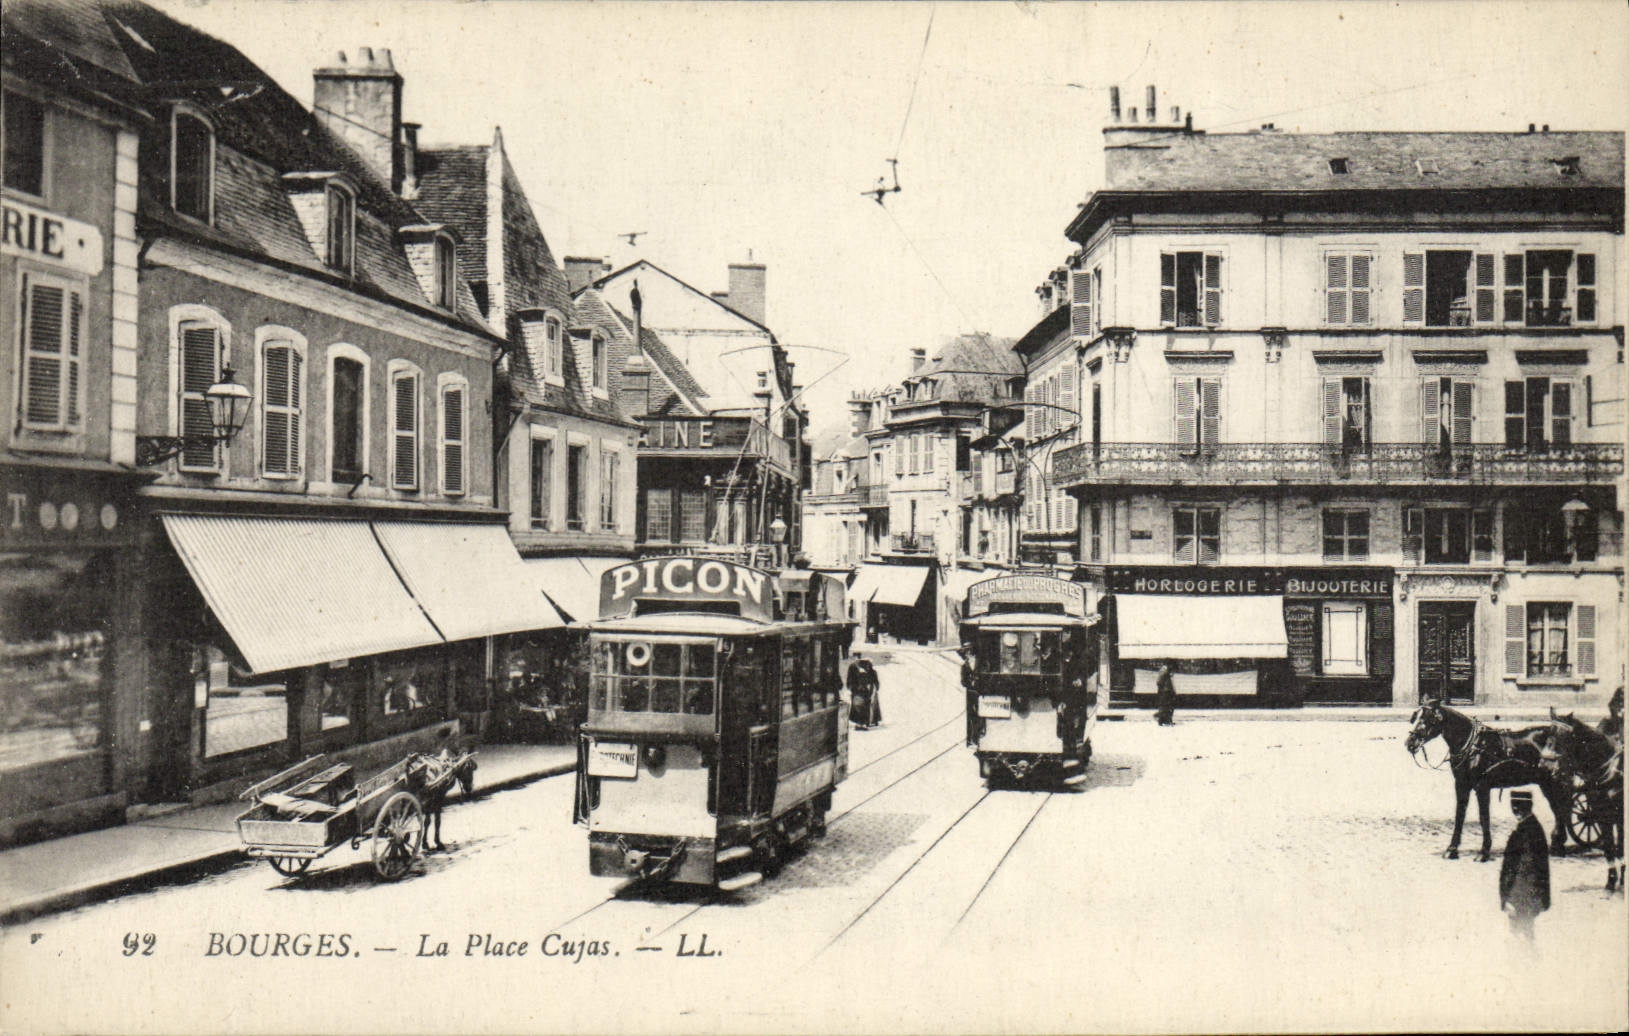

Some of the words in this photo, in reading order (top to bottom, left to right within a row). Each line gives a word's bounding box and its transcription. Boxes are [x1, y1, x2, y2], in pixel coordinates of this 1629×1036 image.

[612, 558, 767, 604] PICON
[1134, 577, 1258, 593] HORLOGERIE
[1286, 577, 1388, 593] BIJOUTERIE
